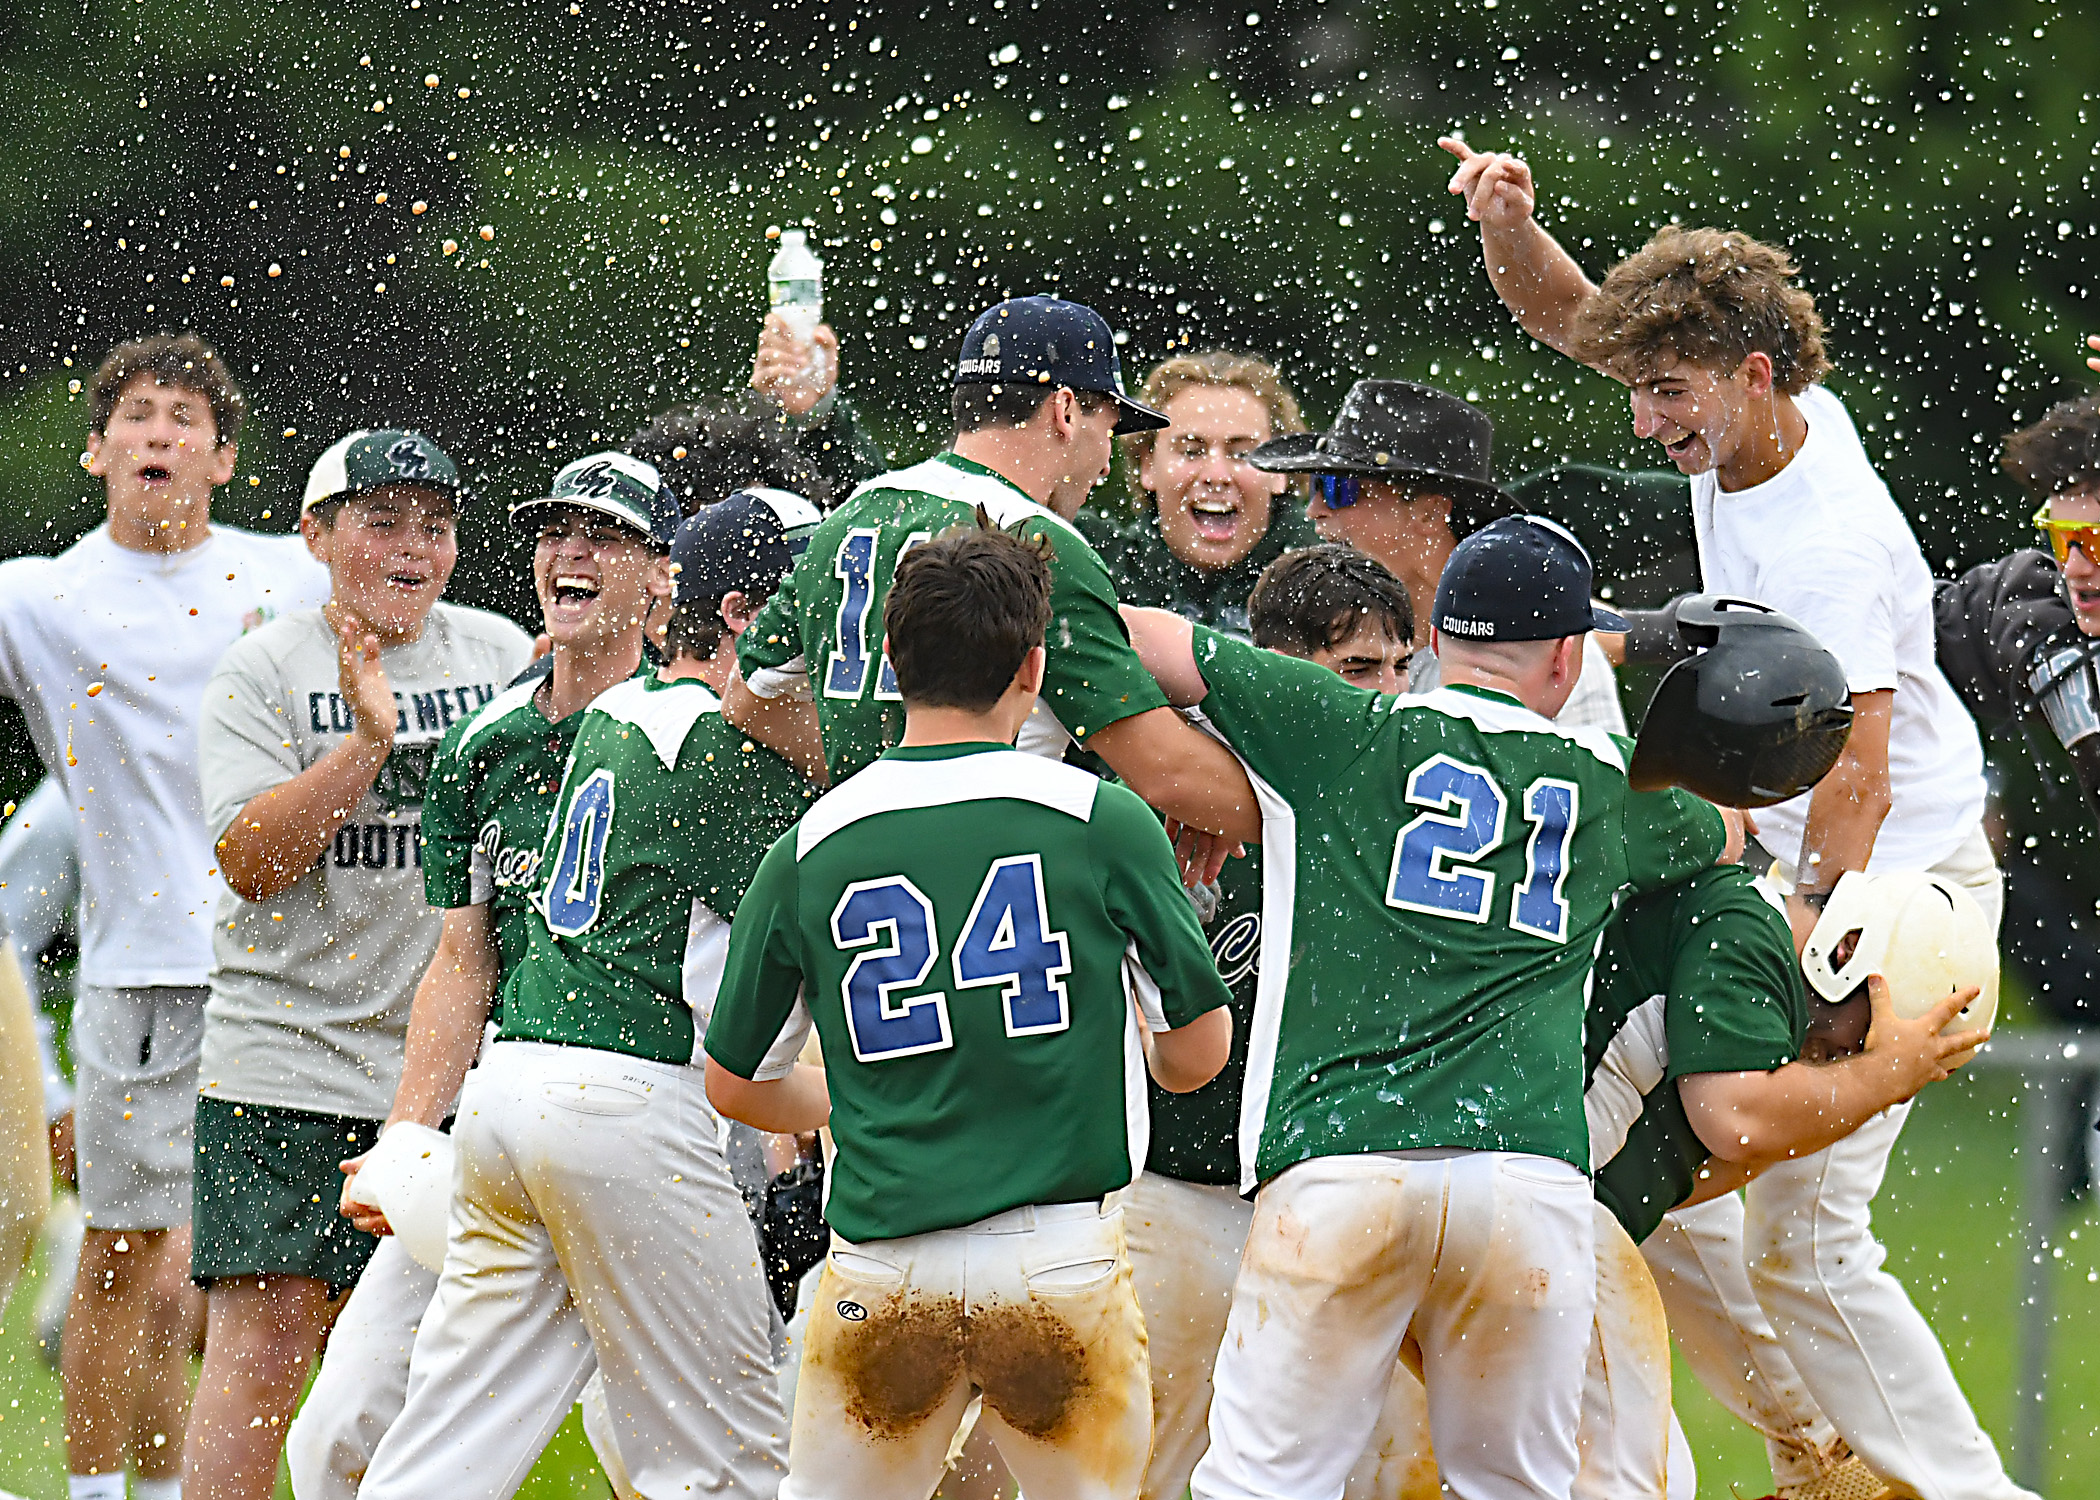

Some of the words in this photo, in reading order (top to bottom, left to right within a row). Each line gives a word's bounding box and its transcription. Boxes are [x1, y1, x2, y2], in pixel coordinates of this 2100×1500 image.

[959, 358, 1002, 376] COUGARS
[1442, 615, 1495, 637] COUGARS
[527, 753, 616, 938] 0
[1385, 752, 1579, 944] 21
[830, 853, 1072, 1062] 24
